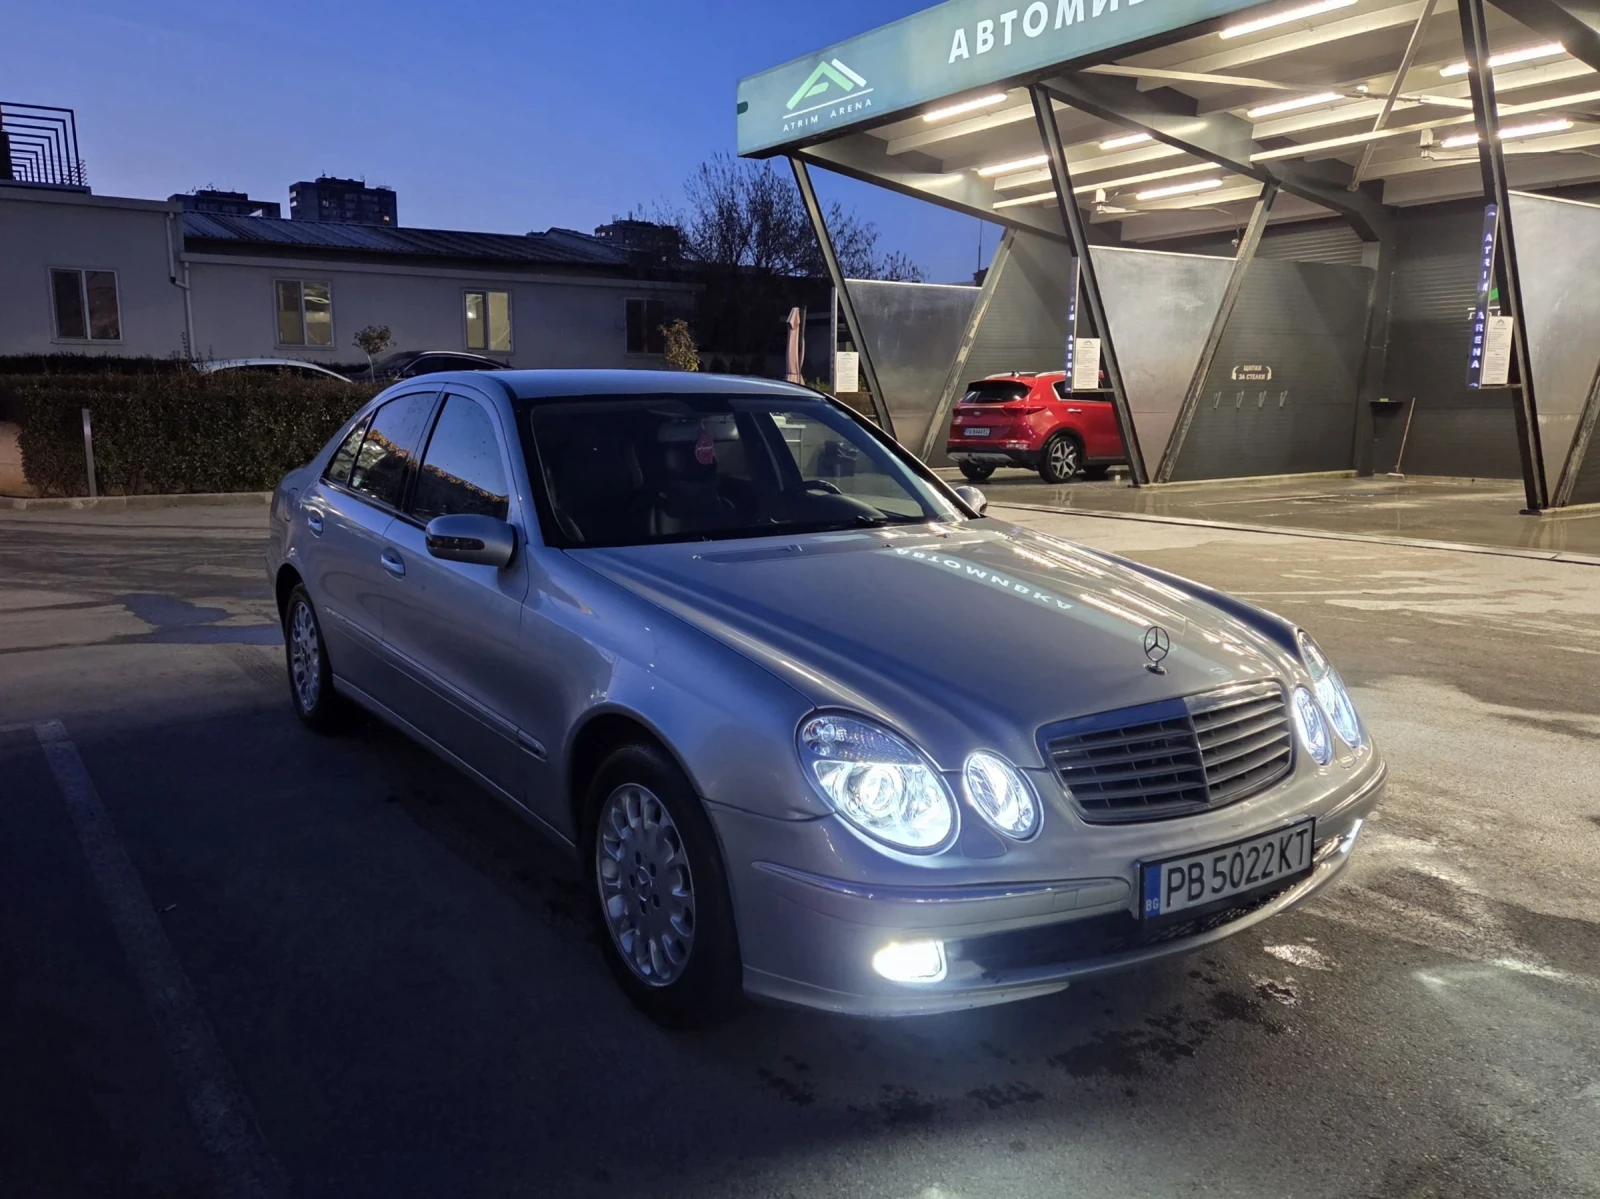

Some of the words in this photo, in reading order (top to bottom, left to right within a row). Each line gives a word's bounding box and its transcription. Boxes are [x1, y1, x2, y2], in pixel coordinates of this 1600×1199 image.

[948, 0, 1145, 63] АВТОМИ
[783, 115, 819, 132] ATRIM
[830, 99, 872, 119] ARENA
[1471, 311, 1484, 369] ARENA
[1145, 898, 1159, 911] BG
